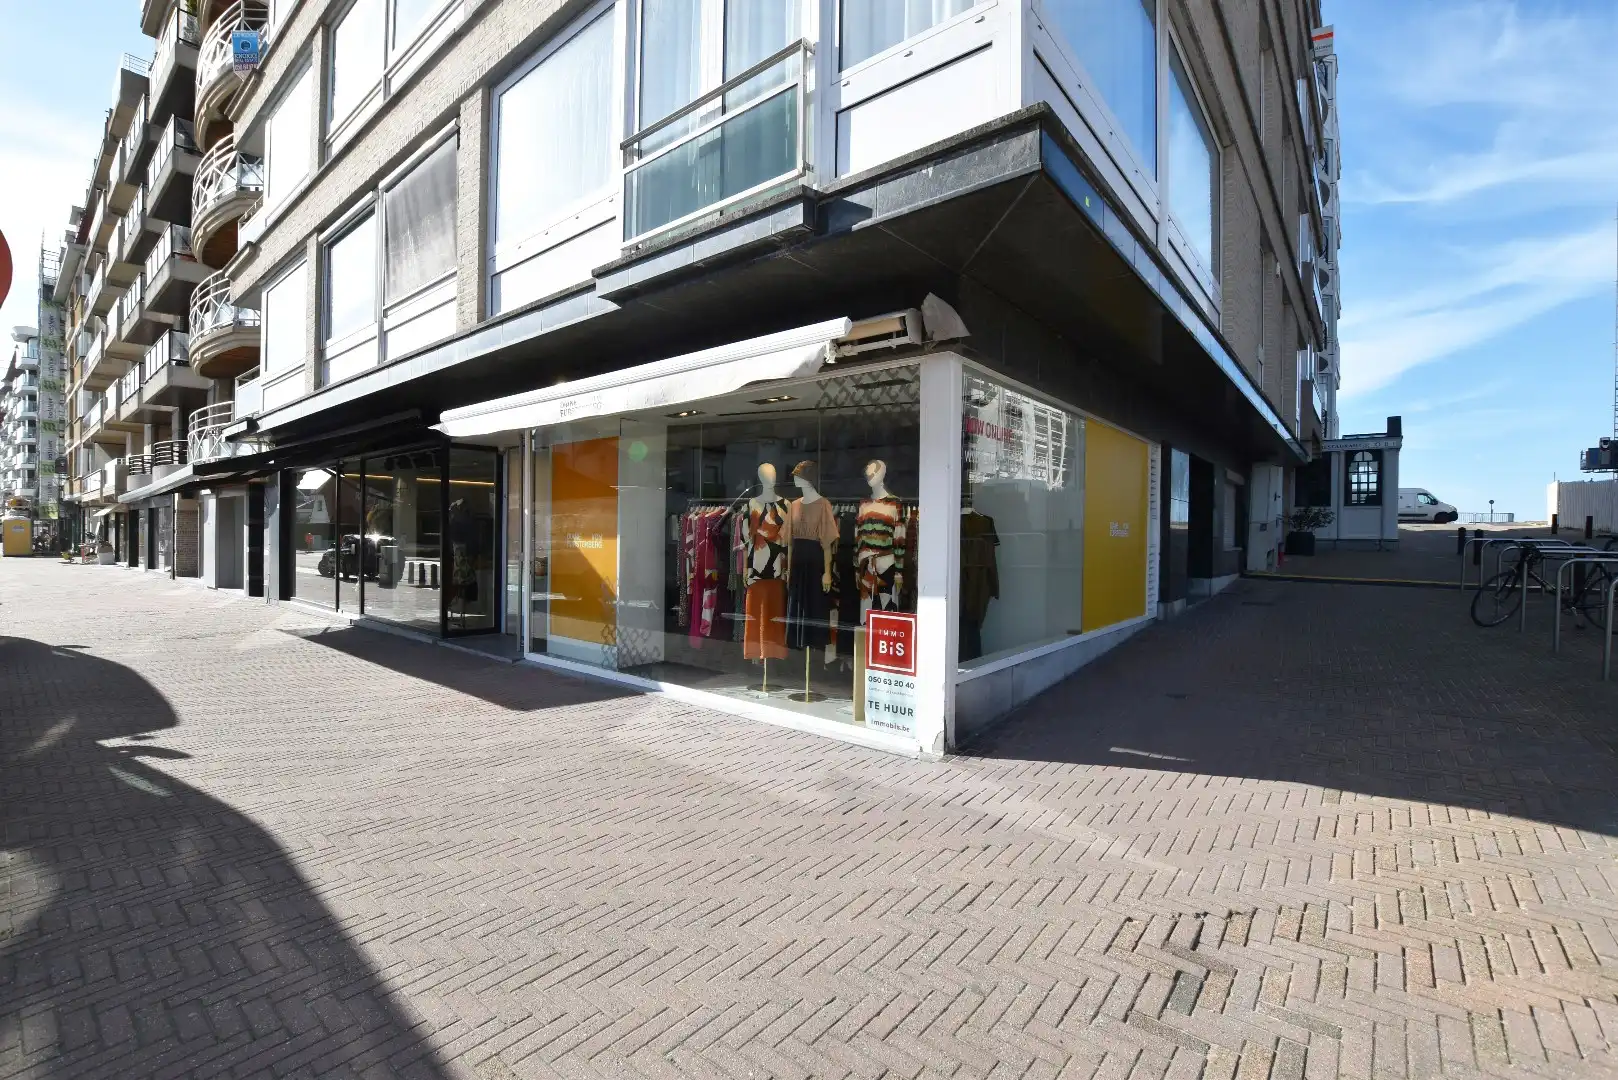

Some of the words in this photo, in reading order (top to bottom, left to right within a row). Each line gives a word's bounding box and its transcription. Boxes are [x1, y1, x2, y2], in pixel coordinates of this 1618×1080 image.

[965, 415, 985, 437] NOW
[879, 629, 905, 638] IMMO
[879, 640, 905, 657] BiS
[868, 675, 882, 684] 050
[883, 678, 893, 686] 63
[894, 680, 903, 688] 20
[905, 682, 914, 690] 40
[868, 700, 880, 710] TE
[884, 703, 914, 717] HUUR
[871, 718, 910, 732] immobis.be
